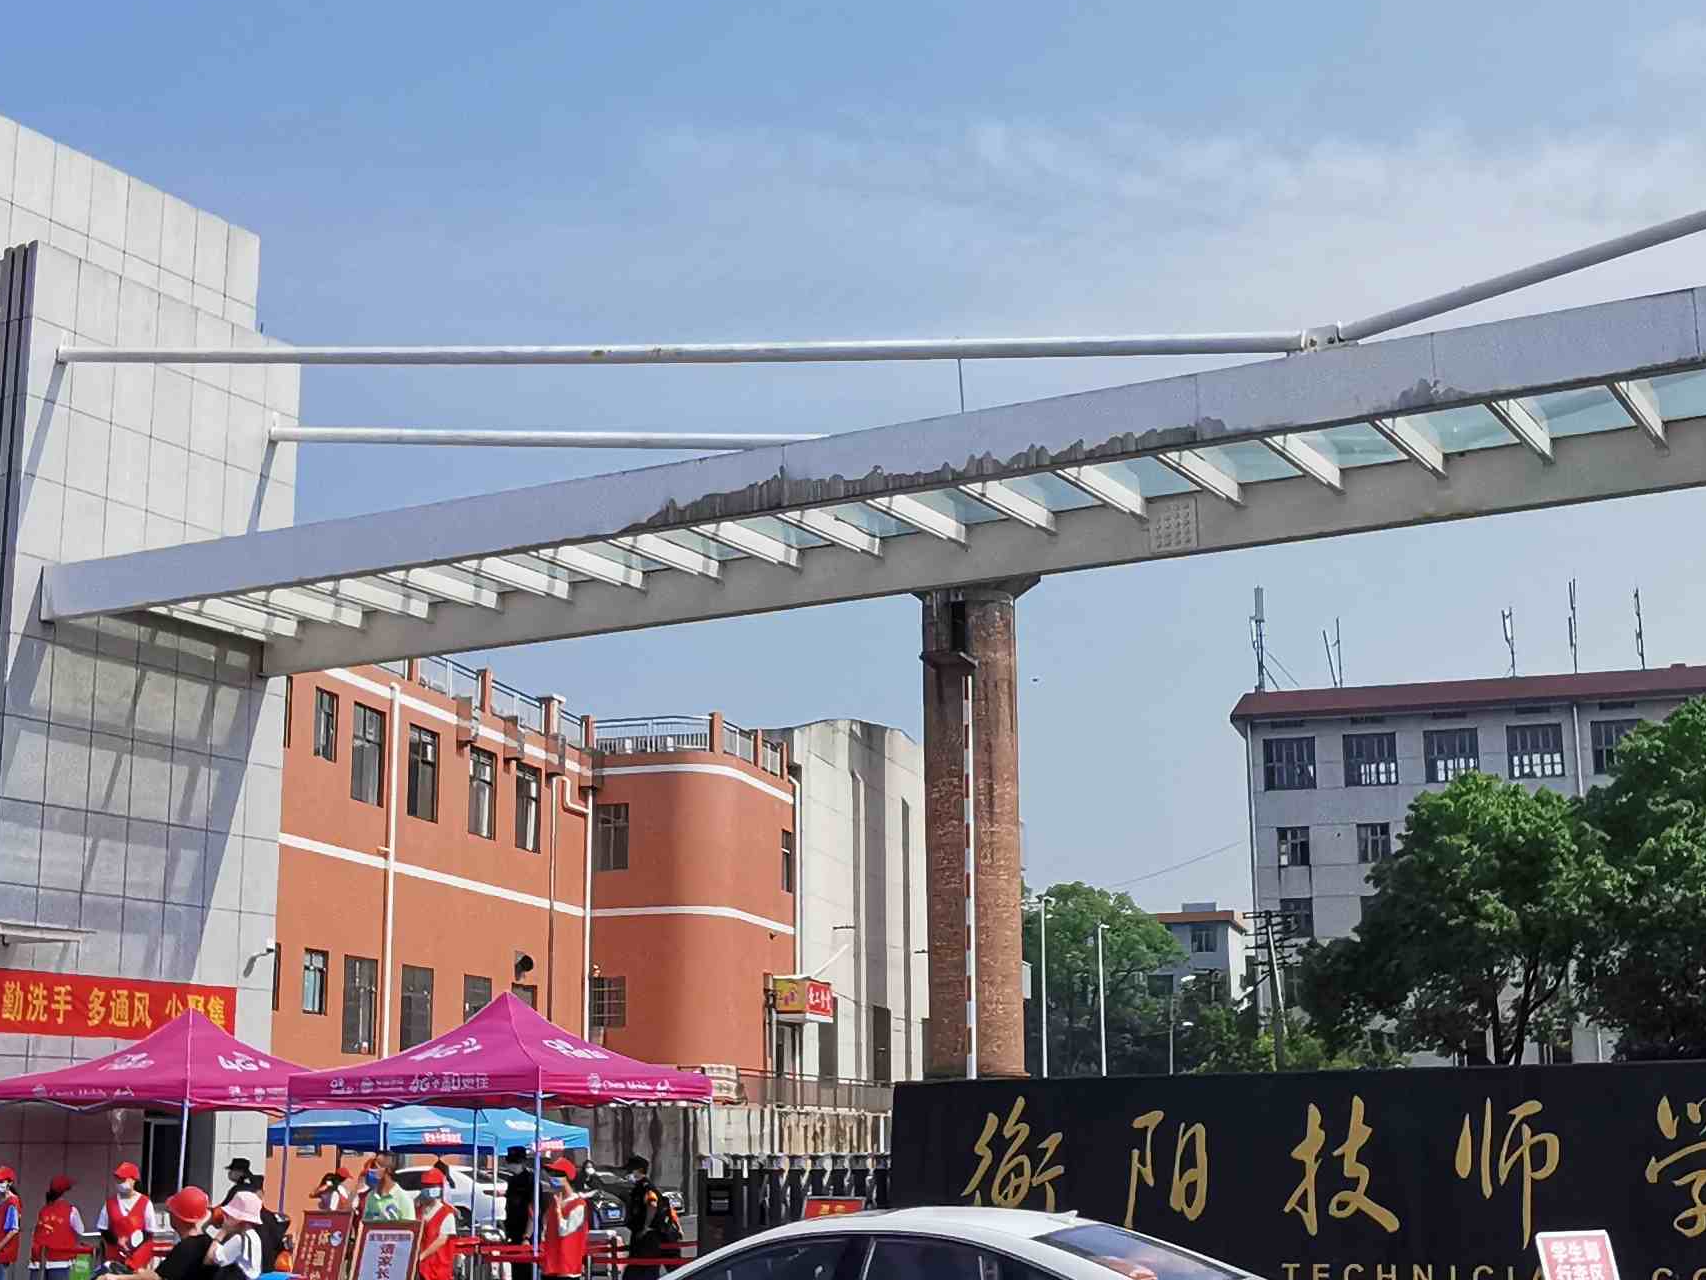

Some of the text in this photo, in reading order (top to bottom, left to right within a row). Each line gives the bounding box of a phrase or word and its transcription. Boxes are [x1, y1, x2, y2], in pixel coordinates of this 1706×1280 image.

[1, 980, 73, 1023] 勤洗手
[87, 987, 153, 1030] 多通风
